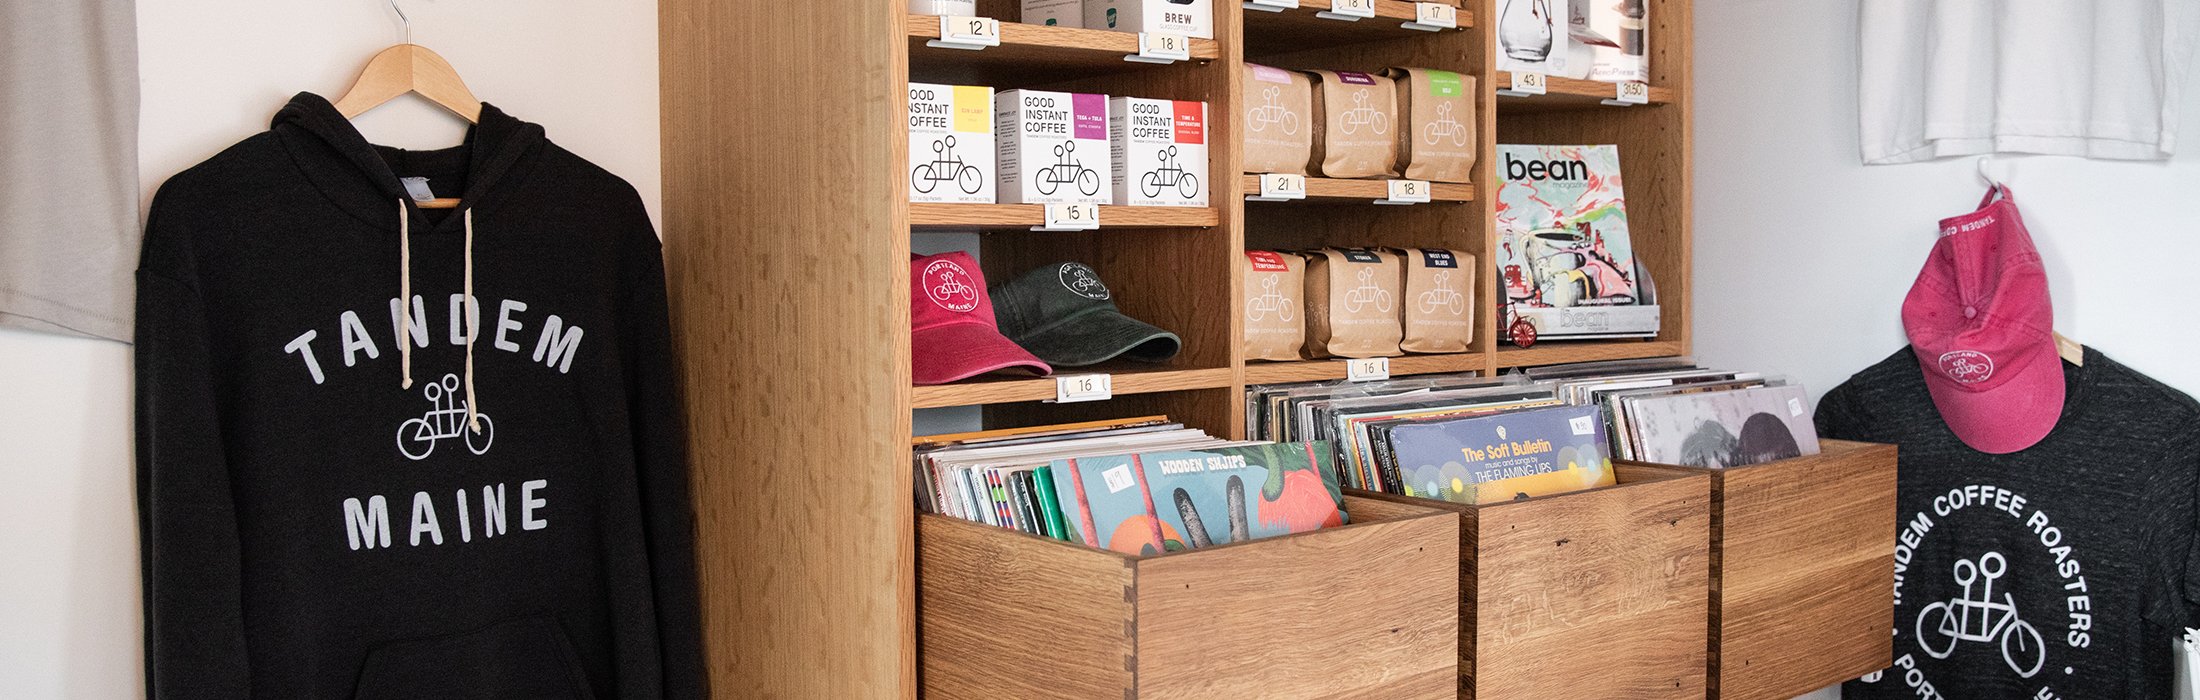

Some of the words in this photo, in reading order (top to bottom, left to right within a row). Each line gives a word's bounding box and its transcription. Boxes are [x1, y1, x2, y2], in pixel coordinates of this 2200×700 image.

[1165, 12, 1192, 24] BREW
[1432, 7, 1440, 18] 17
[969, 20, 982, 35] 12
[1161, 37, 1173, 50] 18
[1524, 74, 1535, 86] 43
[910, 89, 934, 100] OOD
[908, 103, 949, 114] NSTANT
[1025, 97, 1054, 108] GOOD
[1132, 103, 1159, 114] GOOD
[1026, 110, 1068, 120] INSTANT
[1133, 116, 1171, 126] INSTANT
[910, 116, 946, 128] OFFEE
[1025, 122, 1066, 133] COFFEE
[1133, 128, 1170, 138] COFFEE
[1505, 152, 1588, 180] bean
[1278, 178, 1289, 191] 21
[1404, 183, 1415, 195] 18
[1067, 205, 1080, 220] 15
[928, 263, 965, 275] PORTLAND
[1561, 308, 1609, 328] bean
[284, 293, 584, 385] TANDEM
[1364, 362, 1374, 374] 16
[1079, 379, 1092, 391] 16
[1462, 447, 1485, 462] The
[1486, 443, 1510, 459] Soft
[1511, 438, 1552, 456] Bulletin
[1158, 458, 1204, 475] WOODEN
[1502, 459, 1514, 467] and
[1514, 457, 1530, 465] songs
[1475, 470, 1493, 483] THE
[1493, 464, 1534, 480] FLAMING
[1535, 462, 1552, 475] LIPS
[343, 479, 547, 551] MAINE
[1934, 485, 2027, 518] COFFEE
[2026, 510, 2091, 648] ROASTERS
